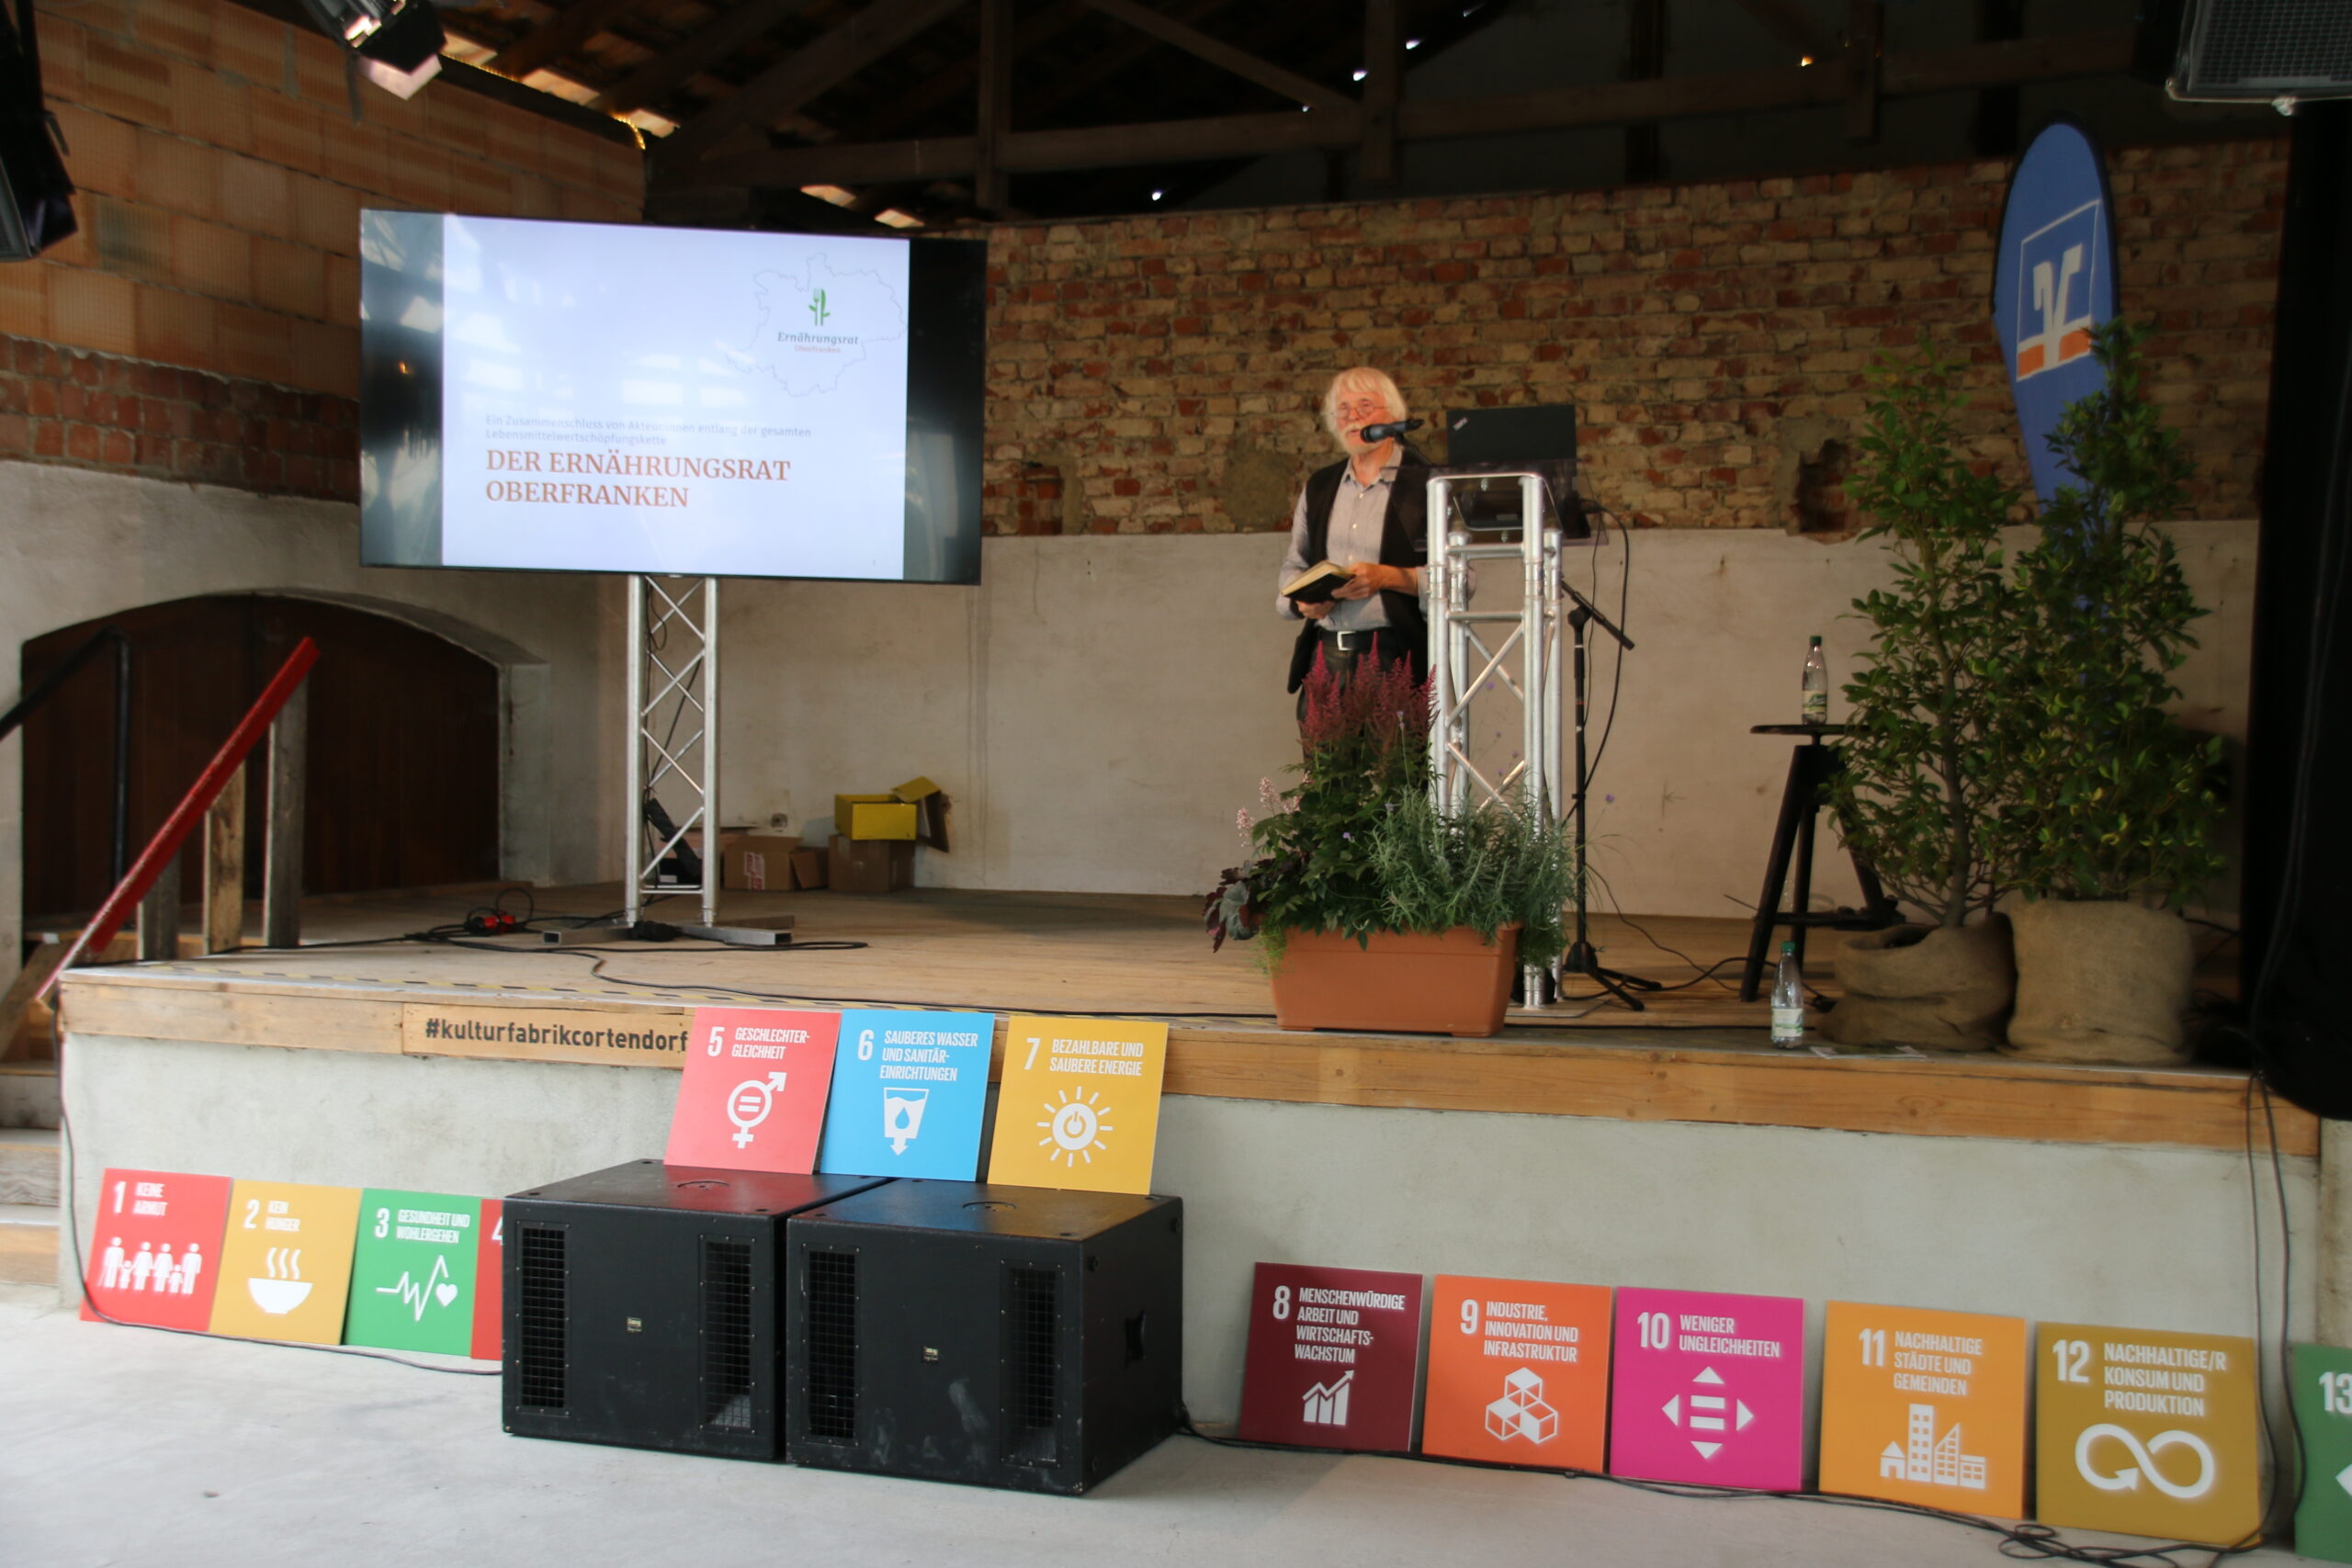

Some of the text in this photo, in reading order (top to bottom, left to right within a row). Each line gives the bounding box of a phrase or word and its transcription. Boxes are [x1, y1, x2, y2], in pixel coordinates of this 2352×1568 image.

[777, 332, 859, 346] Ernährungsrat
[486, 414, 503, 425] Ein
[506, 416, 603, 429] Zusammenschluss
[605, 421, 625, 430] von
[698, 423, 738, 437] entlang
[741, 423, 758, 434] der
[761, 425, 811, 438] gesamten
[486, 448, 791, 481] DER ERNÄHRUNGSRAT
[485, 480, 690, 508] OBERFRANKEN
[425, 1018, 688, 1052] #kulturfabrikcortendorf
[707, 1026, 725, 1056] 5
[735, 1026, 811, 1044] GESCHLECHTER-
[857, 1029, 875, 1061] 6
[884, 1030, 978, 1047] SAUBERES WASSER
[731, 1043, 786, 1060] GLEICHHEIT
[882, 1047, 950, 1064] UND SANITÄR-
[1023, 1037, 1041, 1070] 7
[1052, 1038, 1143, 1057] BEZAHLBARE UND
[879, 1065, 957, 1081] EINRICHTUNGEN
[1049, 1056, 1143, 1076] SAUBERE ENERGIE
[114, 1180, 127, 1213] 1
[135, 1181, 165, 1198] KEINE
[132, 1200, 168, 1216] ARMUT
[243, 1199, 260, 1229] 2
[398, 1209, 470, 1228] GESUNDHEIT UND
[374, 1207, 390, 1238] 3
[396, 1225, 460, 1244] WOHLERGEHEN
[1272, 1285, 1291, 1320] 8
[1299, 1287, 1406, 1310] MENSCHENWÜRDIGE
[1297, 1306, 1359, 1325] ARBEIT UND
[1461, 1299, 1478, 1334] 9
[1487, 1301, 1548, 1321] INDUSTRIE,
[1296, 1325, 1374, 1346] WIRTSCHAFTS-
[1485, 1321, 1578, 1343] INNOVATION UND
[1637, 1312, 1669, 1349] 10
[1679, 1314, 1735, 1334] WENIGER
[1295, 1344, 1355, 1364] WACHSTUM
[1484, 1340, 1577, 1362] INFRASTRUKTUR
[1679, 1335, 1781, 1358] UNGLEICHHEITEN
[1859, 1327, 1885, 1366] 11
[1894, 1331, 1983, 1355] NACHHALTIGE
[1894, 1351, 1972, 1375] STÄDTE UND
[2052, 1339, 2090, 1383] 12
[2104, 1342, 2226, 1371] NACHHALTIGE/R
[1894, 1372, 1968, 1396] GEMEINDEN
[2104, 1366, 2204, 1393] KONSUM UND
[2104, 1390, 2205, 1416] PRODUKTION
[2319, 1371, 2352, 1415] 13
